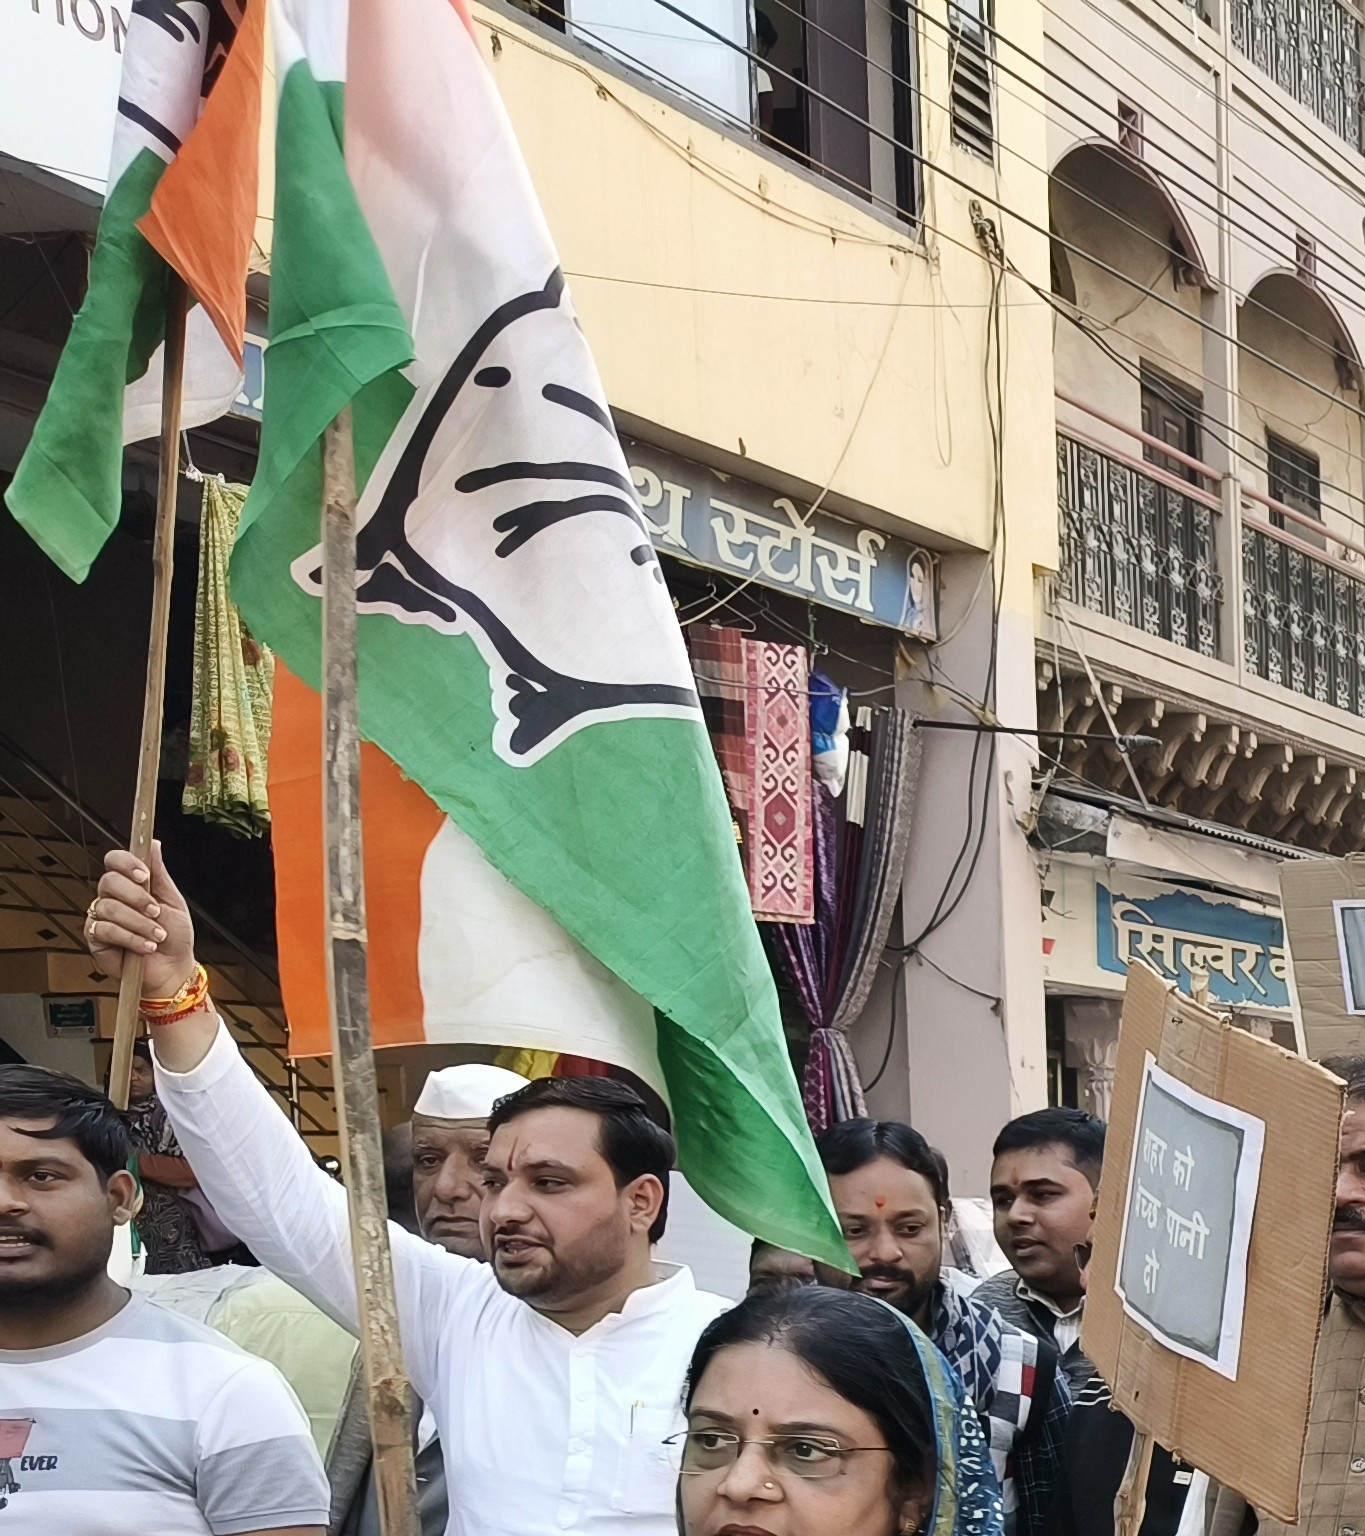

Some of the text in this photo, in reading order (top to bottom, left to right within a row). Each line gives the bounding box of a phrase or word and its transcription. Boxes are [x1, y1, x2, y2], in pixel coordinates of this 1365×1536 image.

[1111, 899, 1268, 998] सिल्वर
[1172, 1144, 1196, 1192] को
[1164, 1209, 1211, 1261] पानी
[1142, 1247, 1161, 1295] दो
[20, 1455, 59, 1472] EVER
